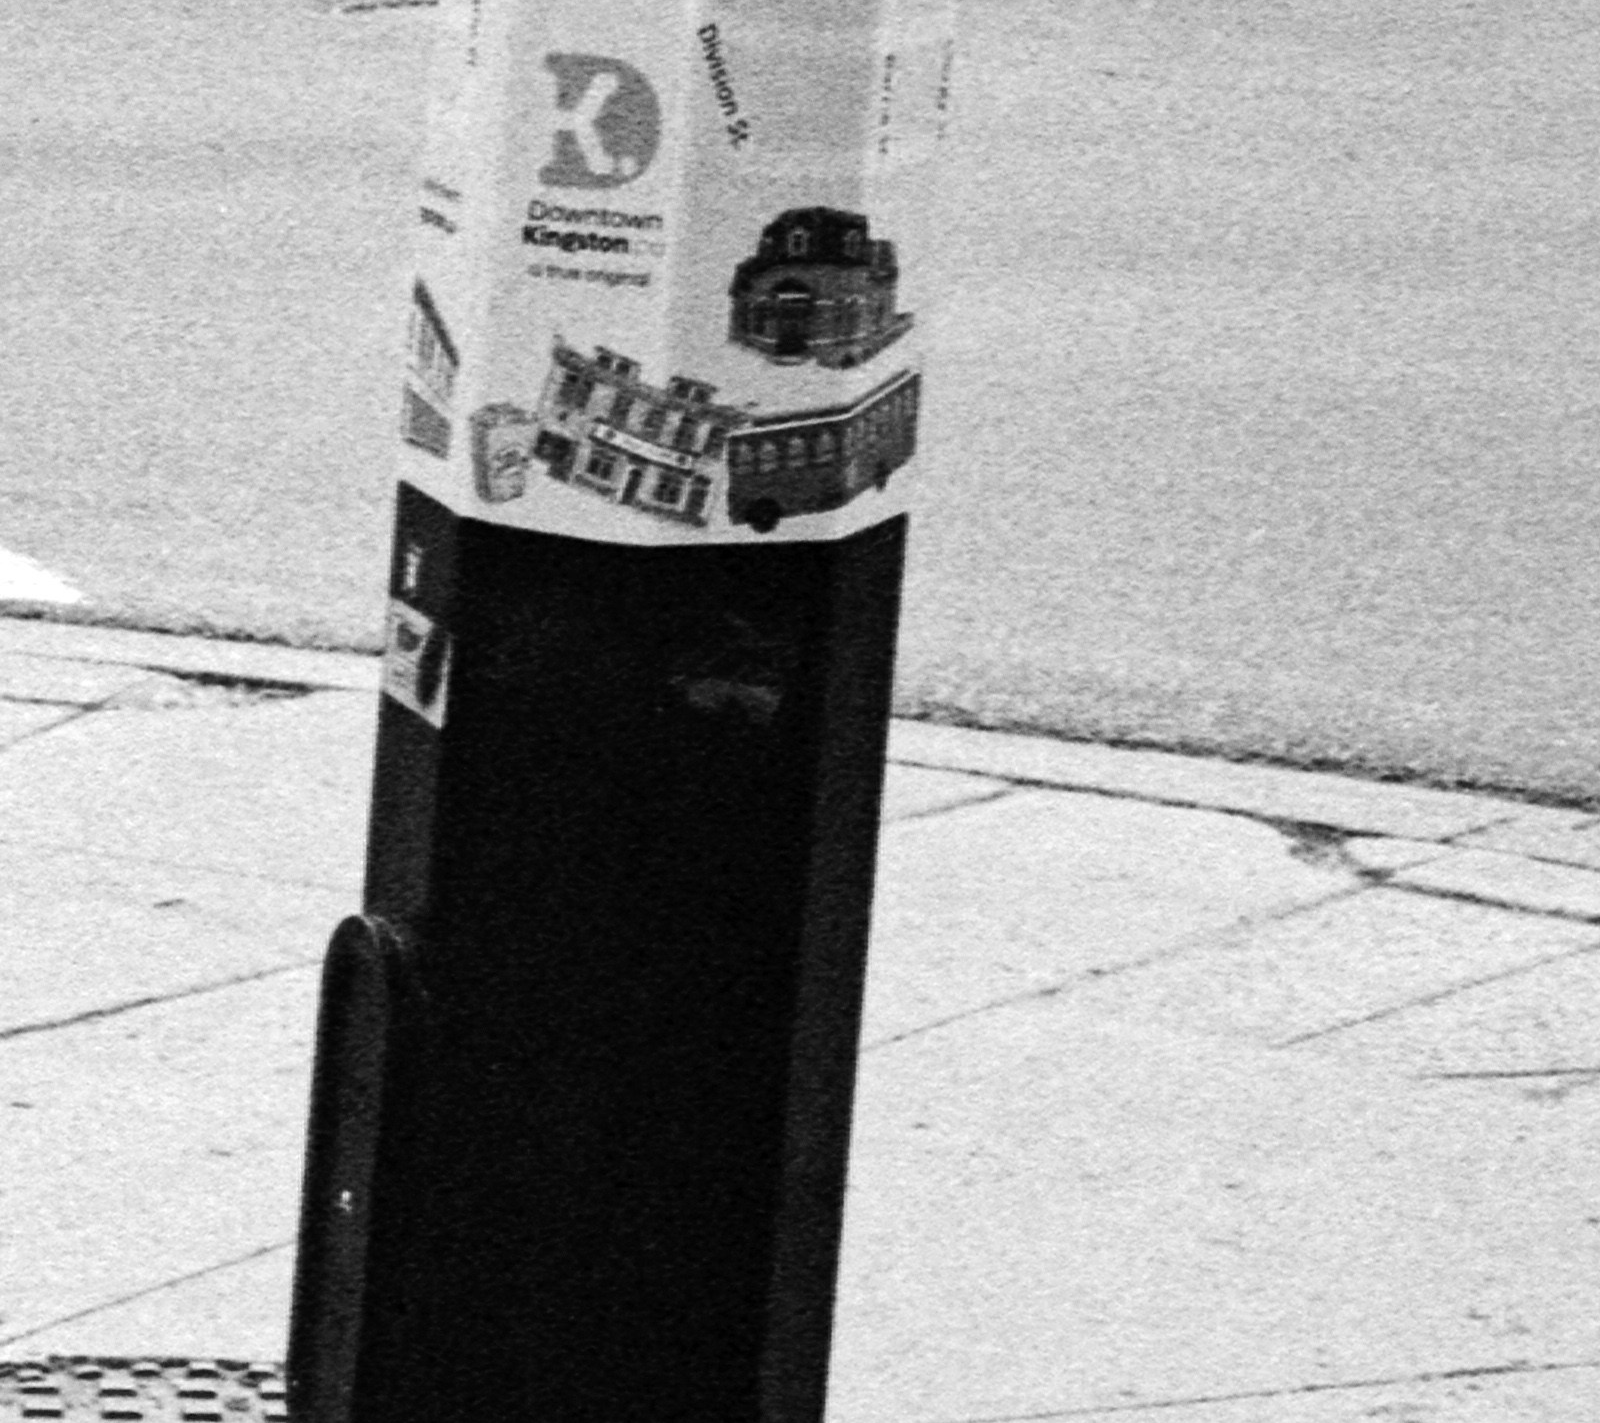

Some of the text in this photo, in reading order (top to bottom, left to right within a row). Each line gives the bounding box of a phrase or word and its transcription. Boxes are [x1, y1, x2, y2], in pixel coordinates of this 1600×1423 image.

[696, 23, 739, 116] Division
[527, 199, 663, 229] Downtown
[521, 224, 629, 253] Kingston
